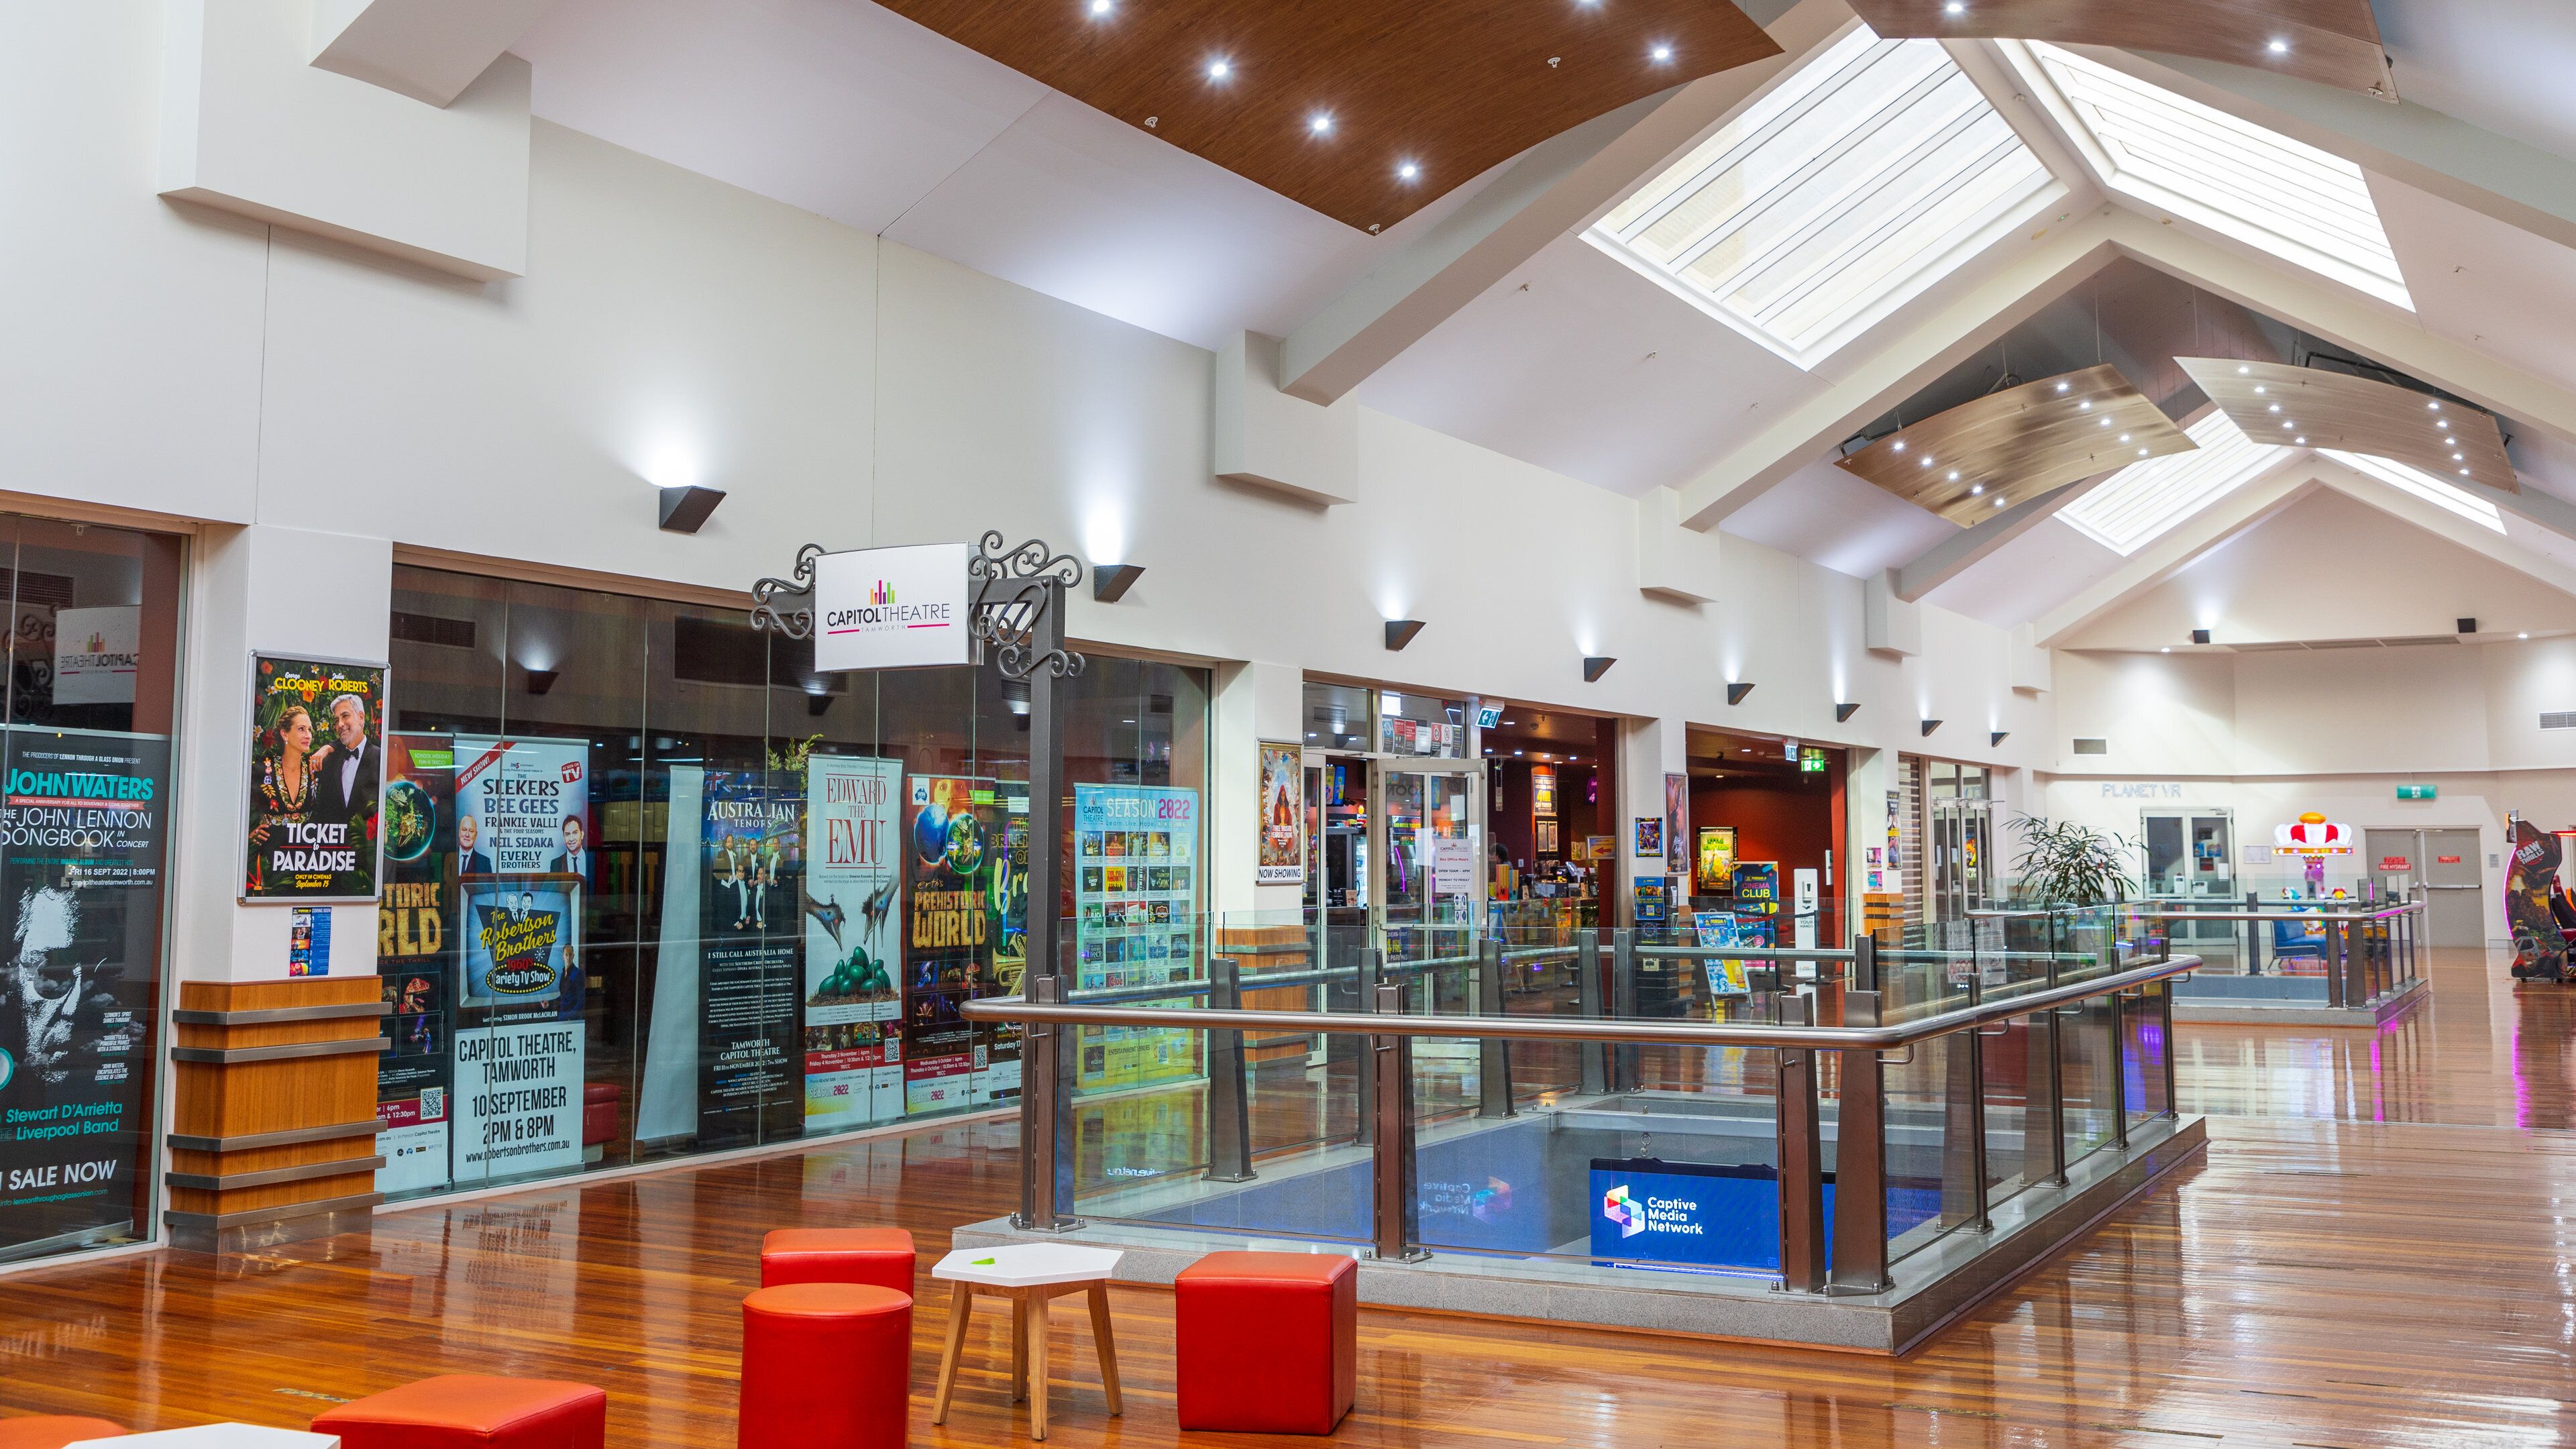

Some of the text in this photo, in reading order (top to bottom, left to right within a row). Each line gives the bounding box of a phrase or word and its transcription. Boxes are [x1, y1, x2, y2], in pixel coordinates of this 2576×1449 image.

[861, 625, 906, 633] TAMWORTH
[274, 677, 368, 693] CLOONEY ROBERTS
[460, 755, 490, 786] NEW SHOW!
[562, 768, 582, 782] TV
[482, 778, 560, 796] SEEKERS
[826, 777, 887, 806] EDWARD
[2102, 783, 2182, 798] PLANET VR
[484, 798, 559, 814] BEE GEES
[848, 805, 866, 818] THE
[1083, 806, 1104, 814] CAPITOL
[1106, 797, 1191, 820] SEASON 2022
[15, 807, 152, 829] JOHN LENNON
[485, 816, 558, 828] FRANKIE VALLI
[734, 818, 771, 828] TENORS
[1083, 814, 1104, 822] THEATRE
[286, 822, 348, 844] TICKET
[116, 840, 149, 848] CONCERT
[313, 841, 319, 851] to
[489, 837, 554, 848] NEIL SEDAKA
[825, 818, 887, 865] EMU
[500, 851, 542, 861] EVERLY
[2516, 840, 2541, 860] RAW
[2520, 848, 2544, 865] THRILLS
[272, 850, 356, 871] PARADISE
[1258, 868, 1301, 878] NOW SHOWING
[295, 879, 329, 890] September 15
[917, 878, 944, 890] erth's
[378, 882, 441, 908] TORIC
[914, 890, 985, 911] PREHISTORIC
[1741, 888, 1771, 898] CLUB
[479, 914, 553, 950] Robertson
[912, 909, 986, 949] WORLD
[496, 930, 557, 962] Brothers
[745, 949, 776, 957] AUSTRALIA
[506, 957, 534, 971] 1960's
[521, 972, 529, 985] TV
[530, 971, 550, 983] Show
[533, 1010, 558, 1019] McLACHLAN
[459, 1030, 577, 1063] CAPITOL THEATRE,
[731, 1038, 770, 1050] TAMWORTH
[994, 1041, 1016, 1051] Saturday
[720, 1046, 781, 1061] CAPITOL THEATRE
[482, 1056, 555, 1085] TAMWORTH
[729, 1061, 754, 1070] NOVEMBER
[833, 1083, 849, 1096] 2022
[930, 1089, 945, 1101] 2022
[386, 1104, 400, 1112] 6pm
[472, 1085, 567, 1118] 10 SEPTEMBER
[6, 1100, 123, 1124] Stewart D'Arrietta
[392, 1110, 416, 1119] 12:30pm
[16, 1118, 119, 1140] Liverpool Band
[482, 1114, 555, 1145] 2PM & 8PM
[8, 1159, 117, 1191] SALE NOW
[1647, 1196, 1697, 1212] Captive
[1648, 1208, 1687, 1222] Media
[1648, 1220, 1703, 1235] Network
